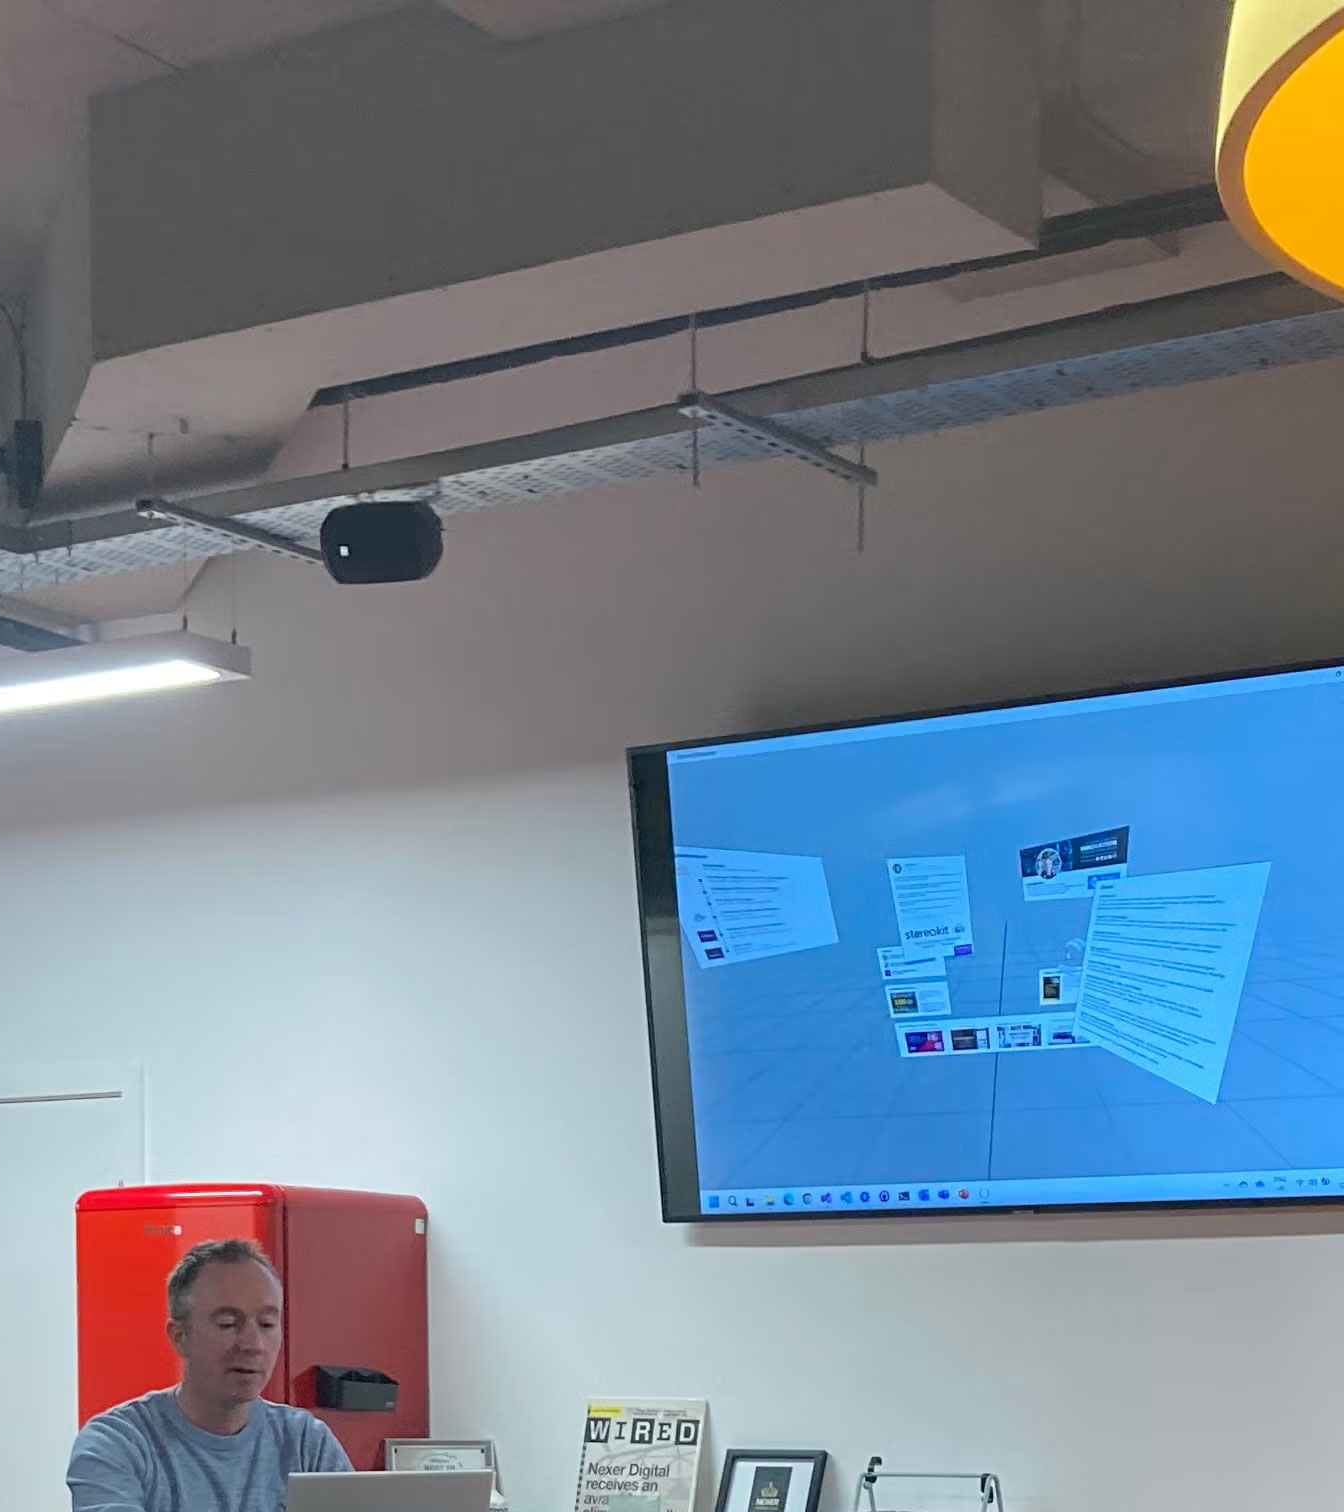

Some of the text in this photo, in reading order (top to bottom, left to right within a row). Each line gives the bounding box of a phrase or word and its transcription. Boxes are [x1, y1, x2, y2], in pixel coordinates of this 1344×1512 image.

[905, 925, 949, 939] stereokit
[584, 1417, 700, 1445] WIRED
[587, 1462, 670, 1480] Nexer Digital
[585, 1480, 658, 1492] receives an
